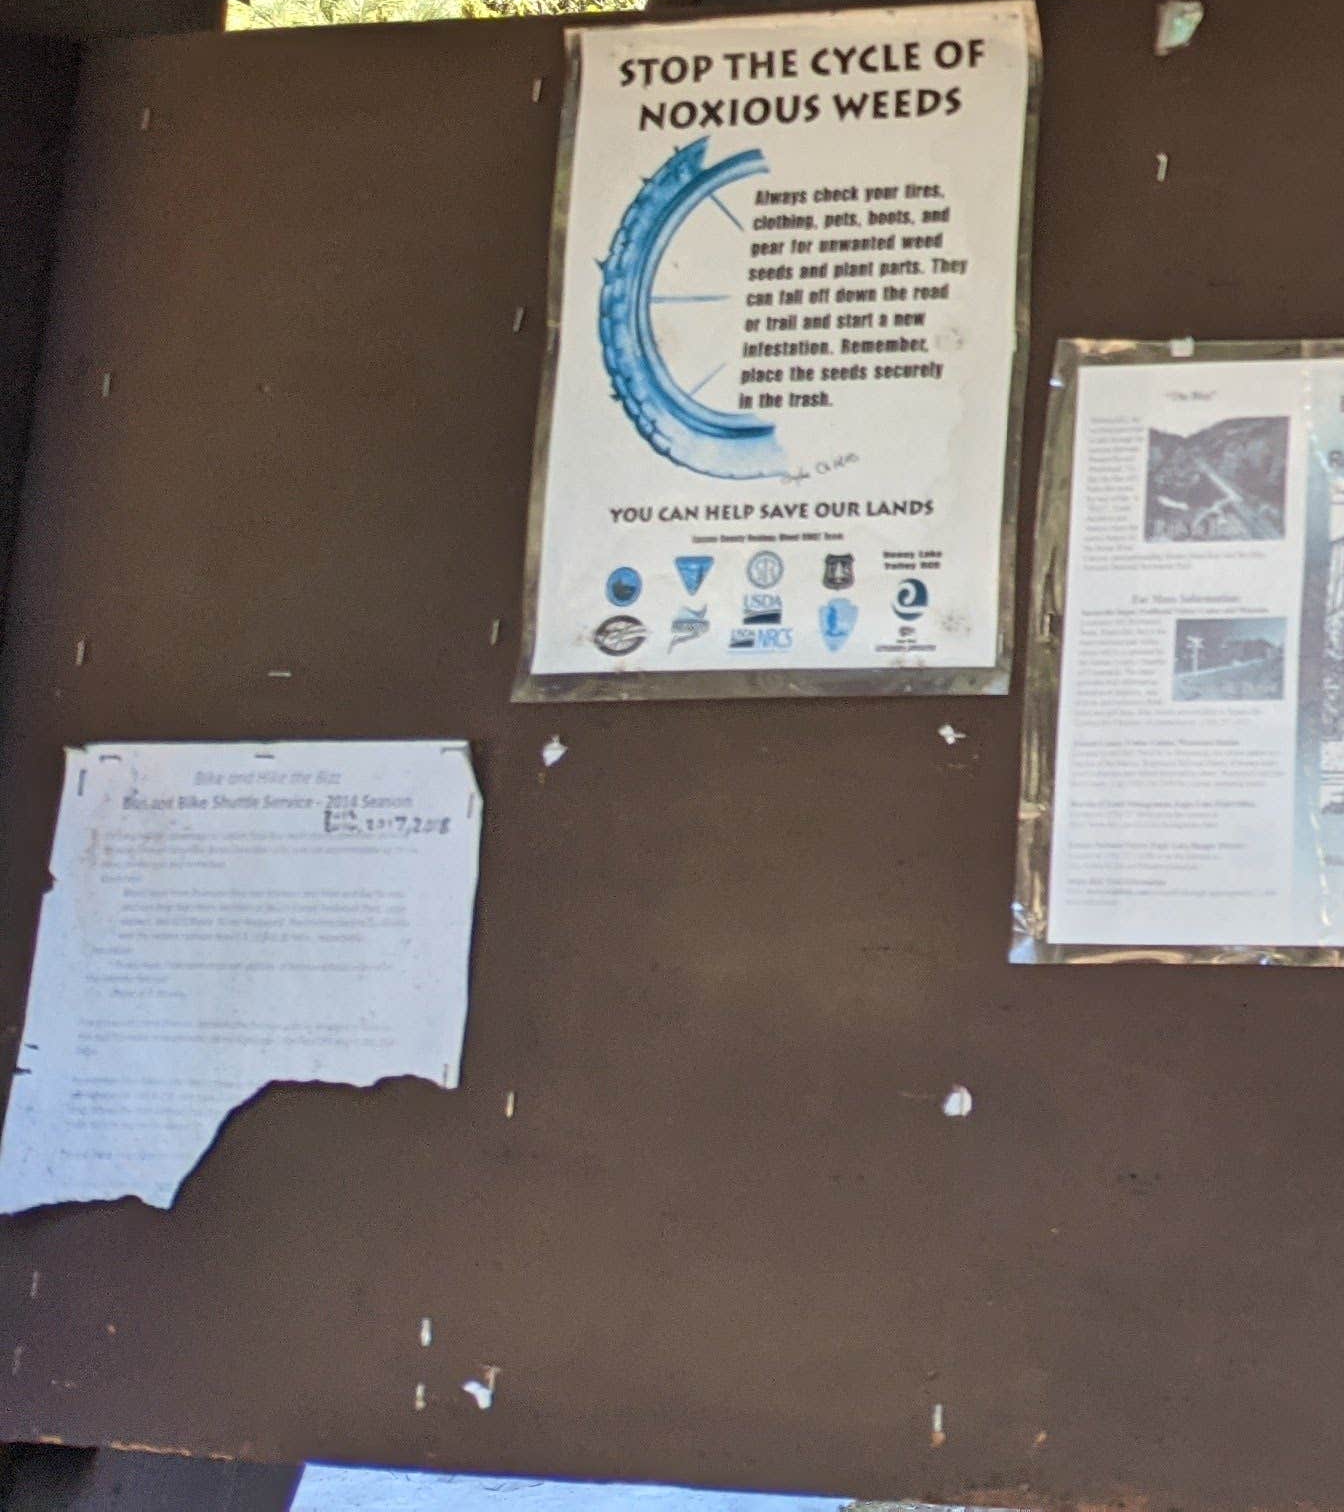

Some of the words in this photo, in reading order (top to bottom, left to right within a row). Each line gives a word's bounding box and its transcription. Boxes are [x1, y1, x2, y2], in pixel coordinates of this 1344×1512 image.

[619, 54, 713, 87] STOP
[723, 48, 797, 80] THE
[810, 41, 920, 76] CYCLE
[934, 38, 984, 69] OF
[639, 93, 820, 131] NOXIOUS
[832, 86, 961, 120] WEEDS
[754, 189, 807, 205] Always
[812, 185, 858, 203] check
[864, 186, 898, 202] your
[921, 206, 950, 223] and
[609, 506, 652, 523] YOU
[657, 505, 698, 522] CAN
[705, 503, 754, 520] HELP
[759, 502, 808, 519] SAVE
[813, 501, 860, 518] OUR
[865, 499, 933, 516] LANDS
